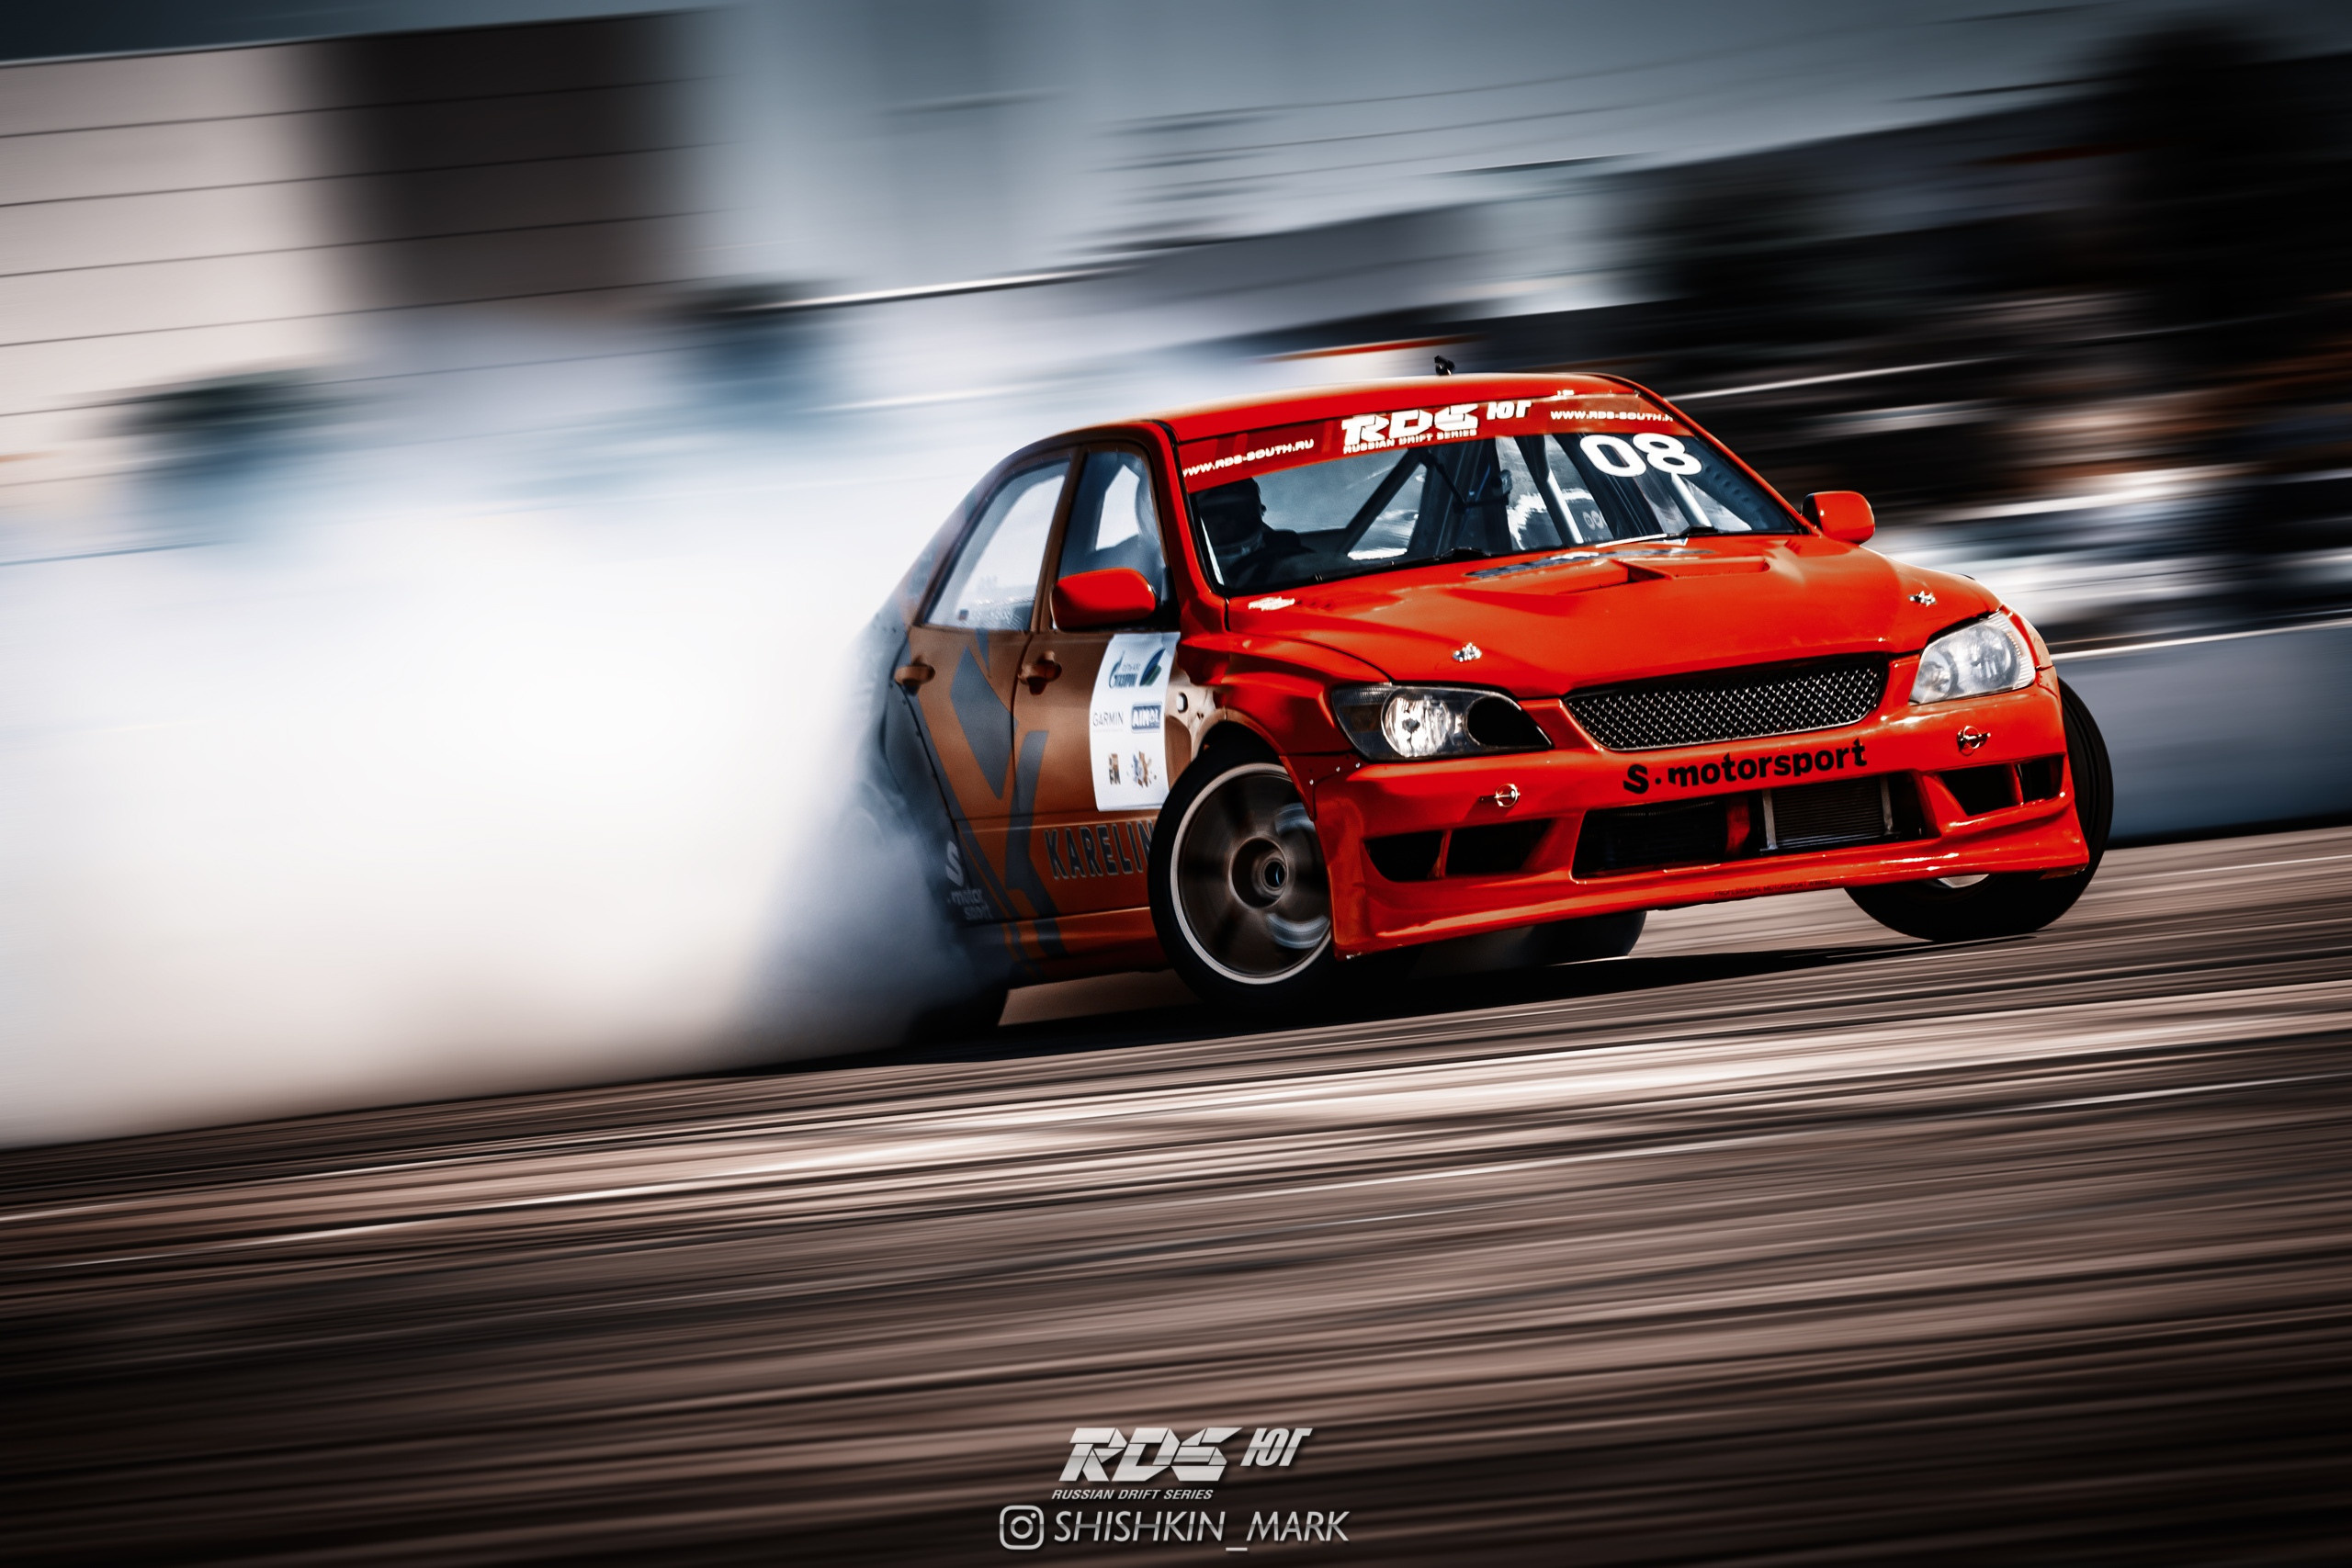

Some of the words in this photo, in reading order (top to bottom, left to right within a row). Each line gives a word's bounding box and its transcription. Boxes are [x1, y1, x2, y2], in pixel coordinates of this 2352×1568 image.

[1341, 403, 1478, 446] RDS
[1550, 411, 1674, 422] WWW.RDS-SOUTH.R
[1398, 433, 1434, 446] DRIFT
[1437, 429, 1477, 441] SERIES
[1579, 433, 1702, 477] 08
[1092, 711, 1124, 727] GARMIN
